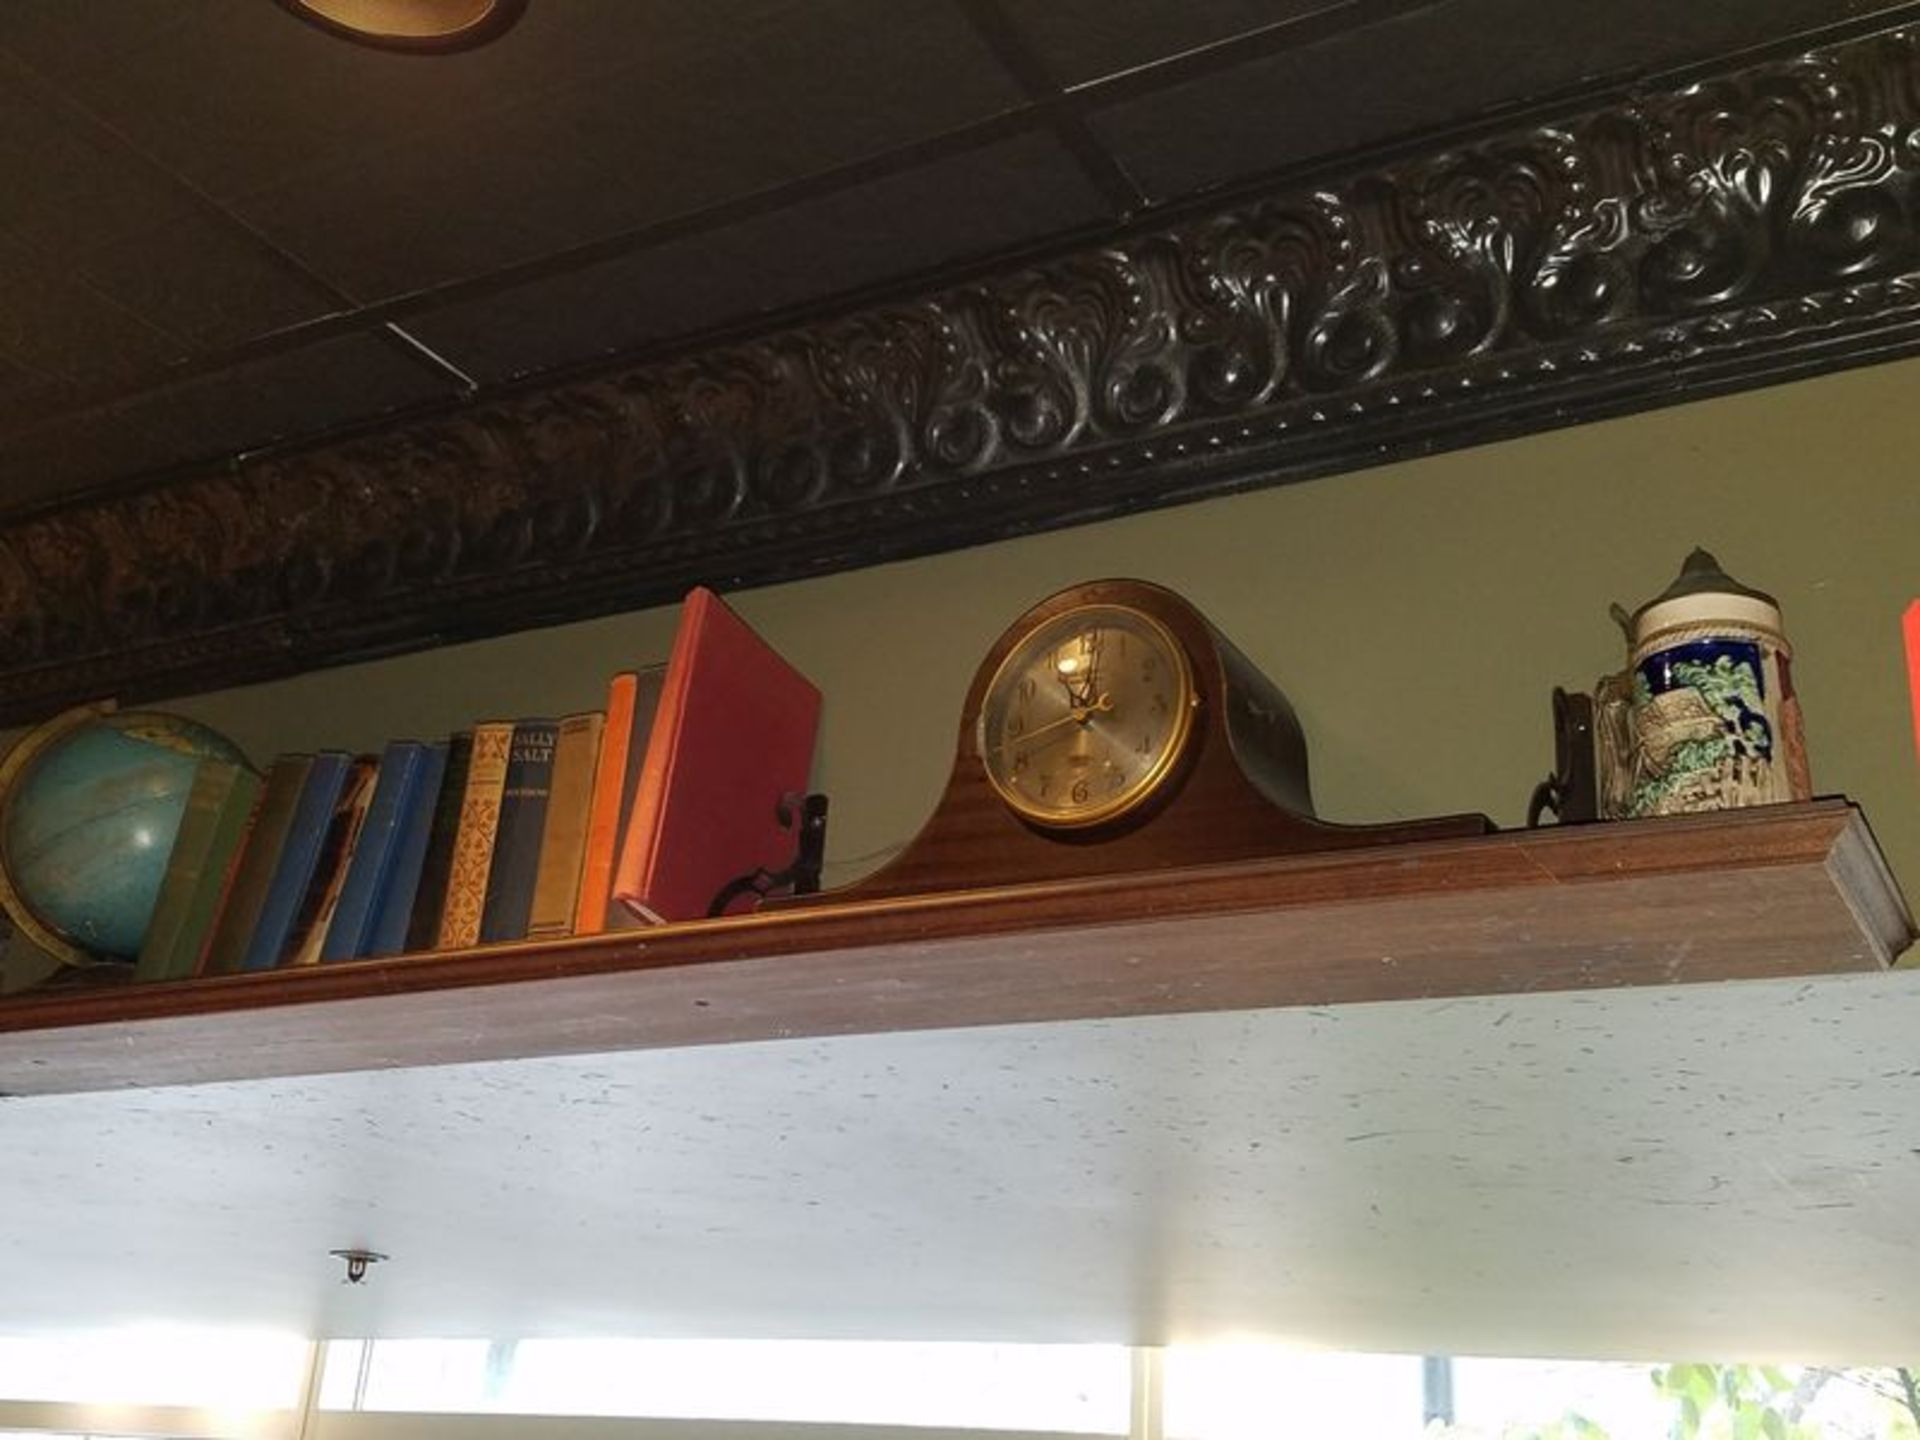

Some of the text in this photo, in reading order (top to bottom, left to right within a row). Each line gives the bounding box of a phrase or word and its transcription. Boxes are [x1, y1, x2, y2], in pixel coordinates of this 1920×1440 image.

[514, 731, 555, 747] SALLY
[512, 748, 552, 762] SALT
[1071, 780, 1090, 804] 6
